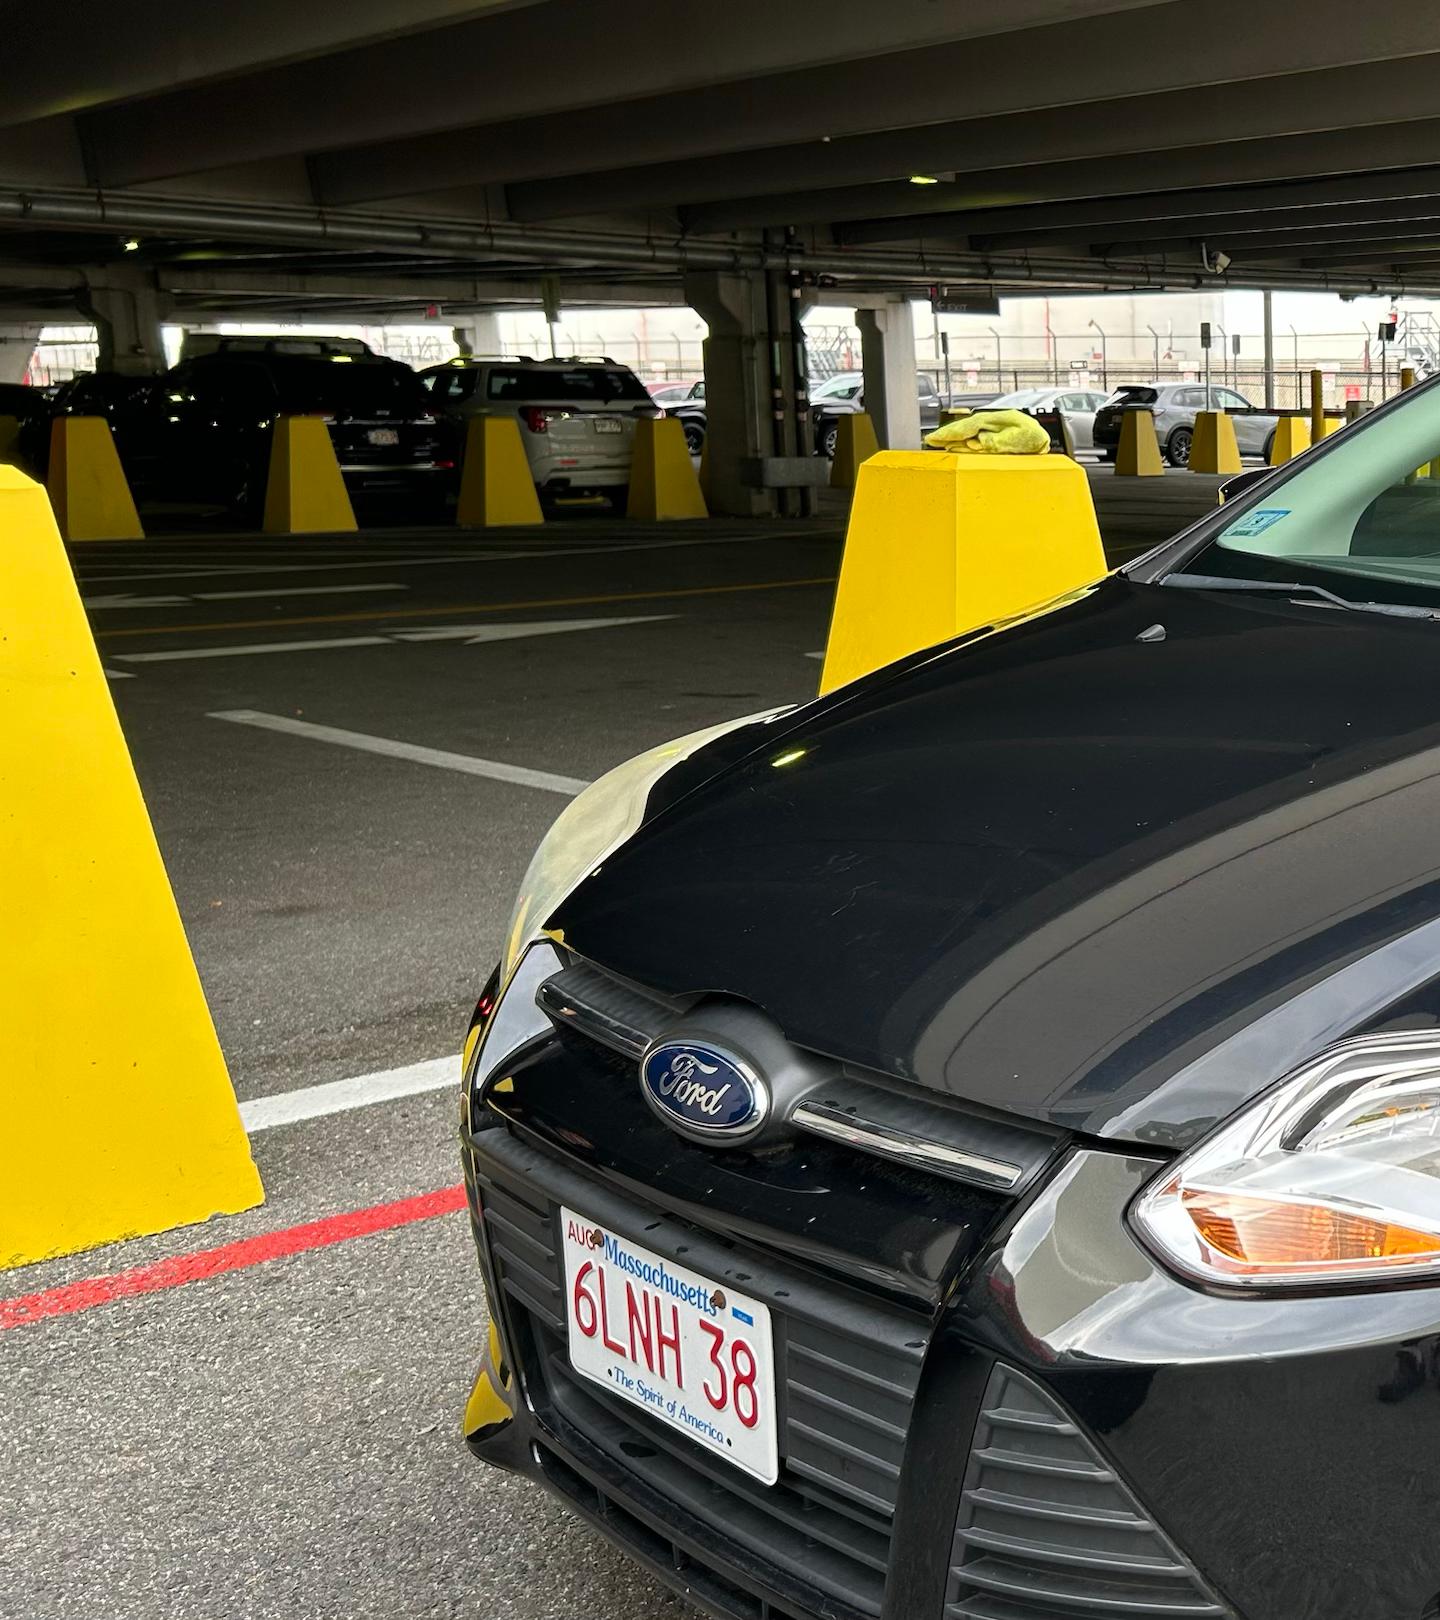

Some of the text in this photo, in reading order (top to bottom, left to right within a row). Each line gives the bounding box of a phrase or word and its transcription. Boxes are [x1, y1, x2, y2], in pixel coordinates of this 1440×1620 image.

[659, 1053, 732, 1116] Ford
[604, 1233, 717, 1317] Massachusetts
[574, 1261, 759, 1429] 6LNH 38
[614, 1366, 724, 1444] The Spirit of America
